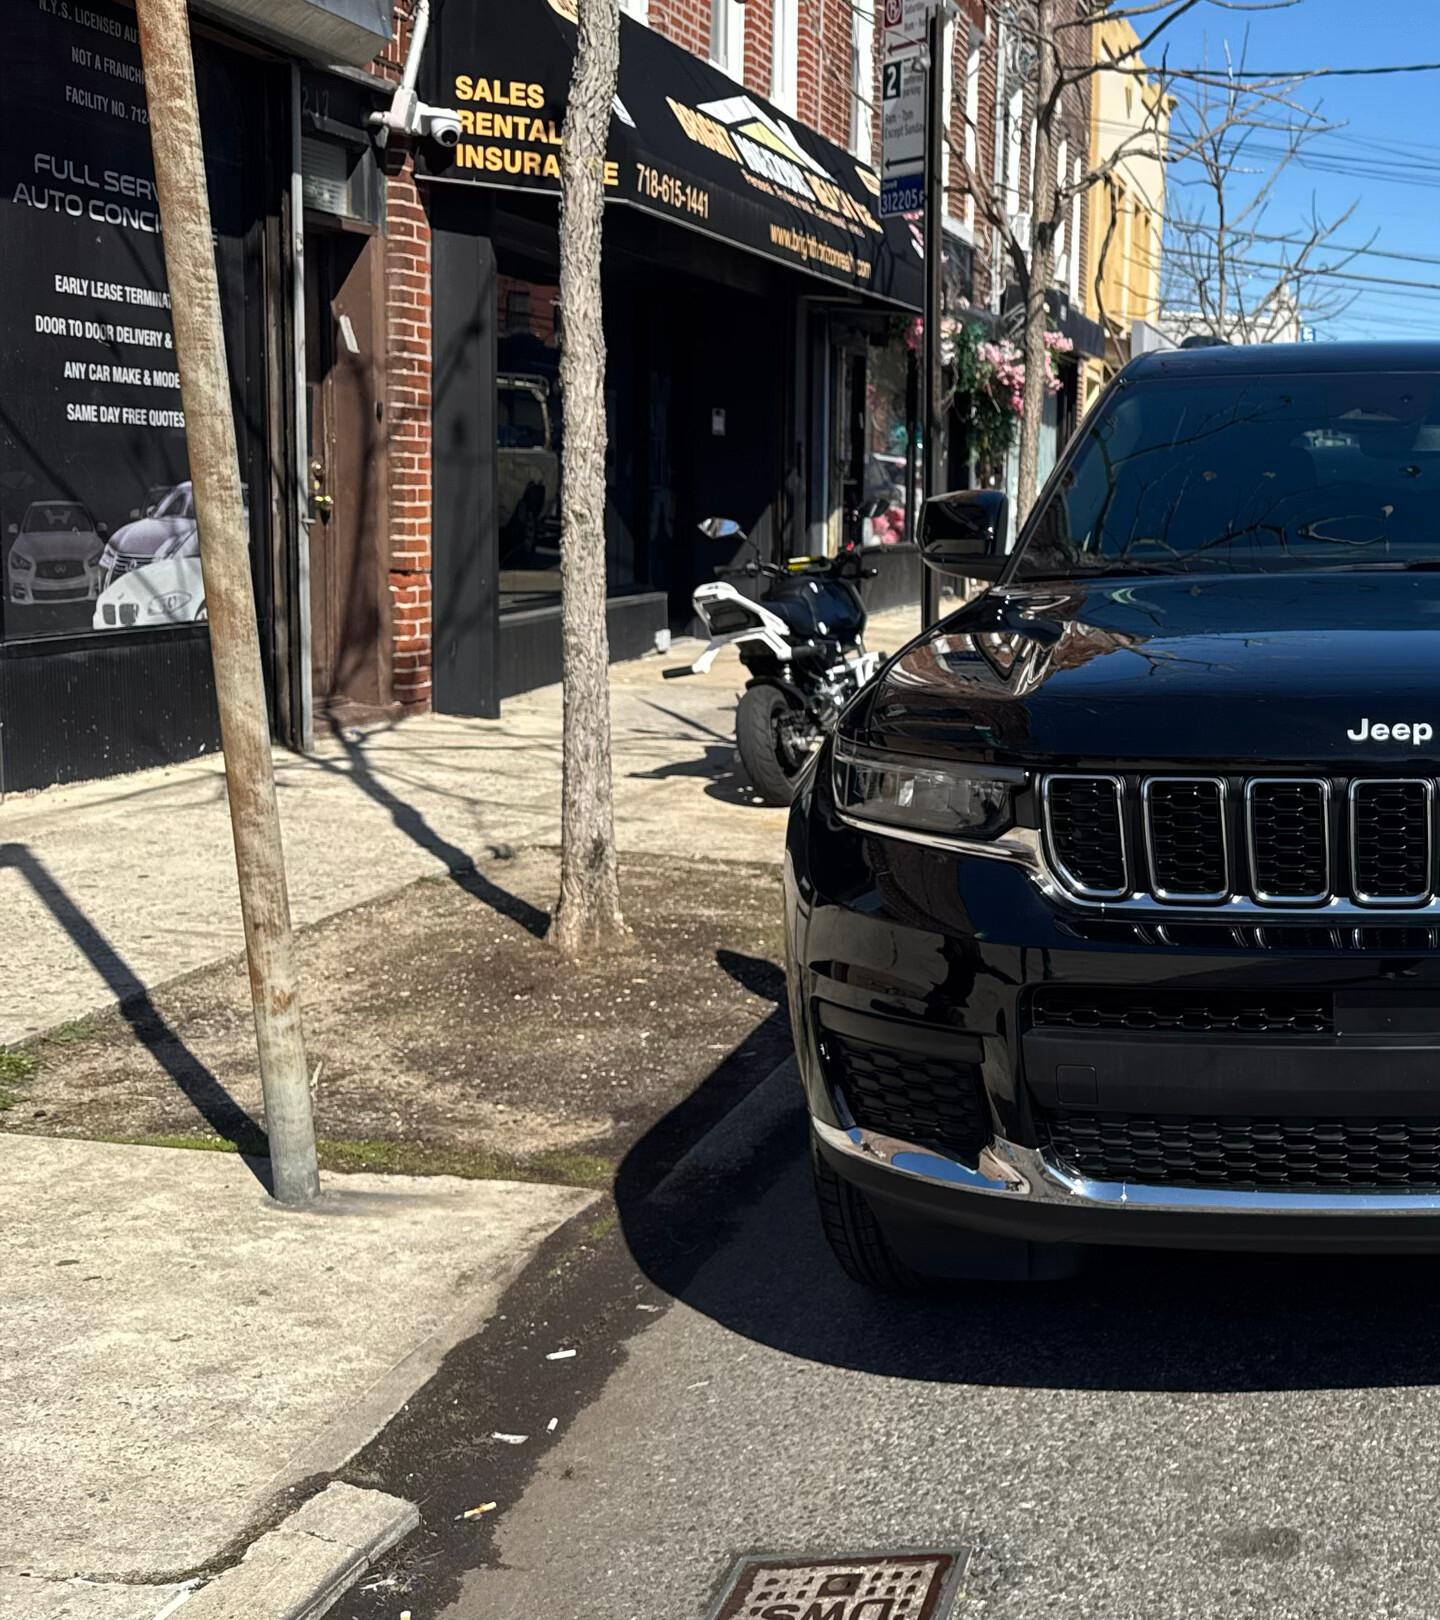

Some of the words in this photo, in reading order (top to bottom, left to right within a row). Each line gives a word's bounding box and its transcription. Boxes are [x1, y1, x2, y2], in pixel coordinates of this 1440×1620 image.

[75, 7, 122, 38] LICENSED
[124, 25, 140, 44] AU
[71, 46, 93, 69] NOT
[94, 55, 102, 71] A
[455, 75, 545, 109] SALES
[886, 65, 897, 97] 2
[65, 85, 108, 113] FACILITY
[111, 99, 128, 119] NO.
[131, 106, 150, 125] 712
[34, 153, 100, 188] FULL
[456, 143, 619, 186] INSURAE
[12, 182, 83, 217] AUTO
[88, 199, 163, 234] CONCI
[636, 162, 709, 219] 718-615-1441
[55, 274, 89, 296] EARLY
[91, 282, 124, 302] LEASE
[124, 286, 172, 309] TERMINA
[35, 314, 67, 336] DOOR
[68, 319, 83, 338] TO
[85, 321, 114, 342] DOOR
[116, 326, 163, 348] DELIVERY
[164, 333, 173, 349] &
[64, 361, 87, 380] ANY
[89, 363, 111, 382] CAR
[113, 366, 142, 385] MAKE
[143, 369, 152, 386] &
[67, 403, 98, 422] SAME
[100, 406, 121, 424] DAY
[122, 407, 147, 425] FREE
[149, 410, 186, 428] QUOTES
[1346, 717, 1434, 746] Jeep
